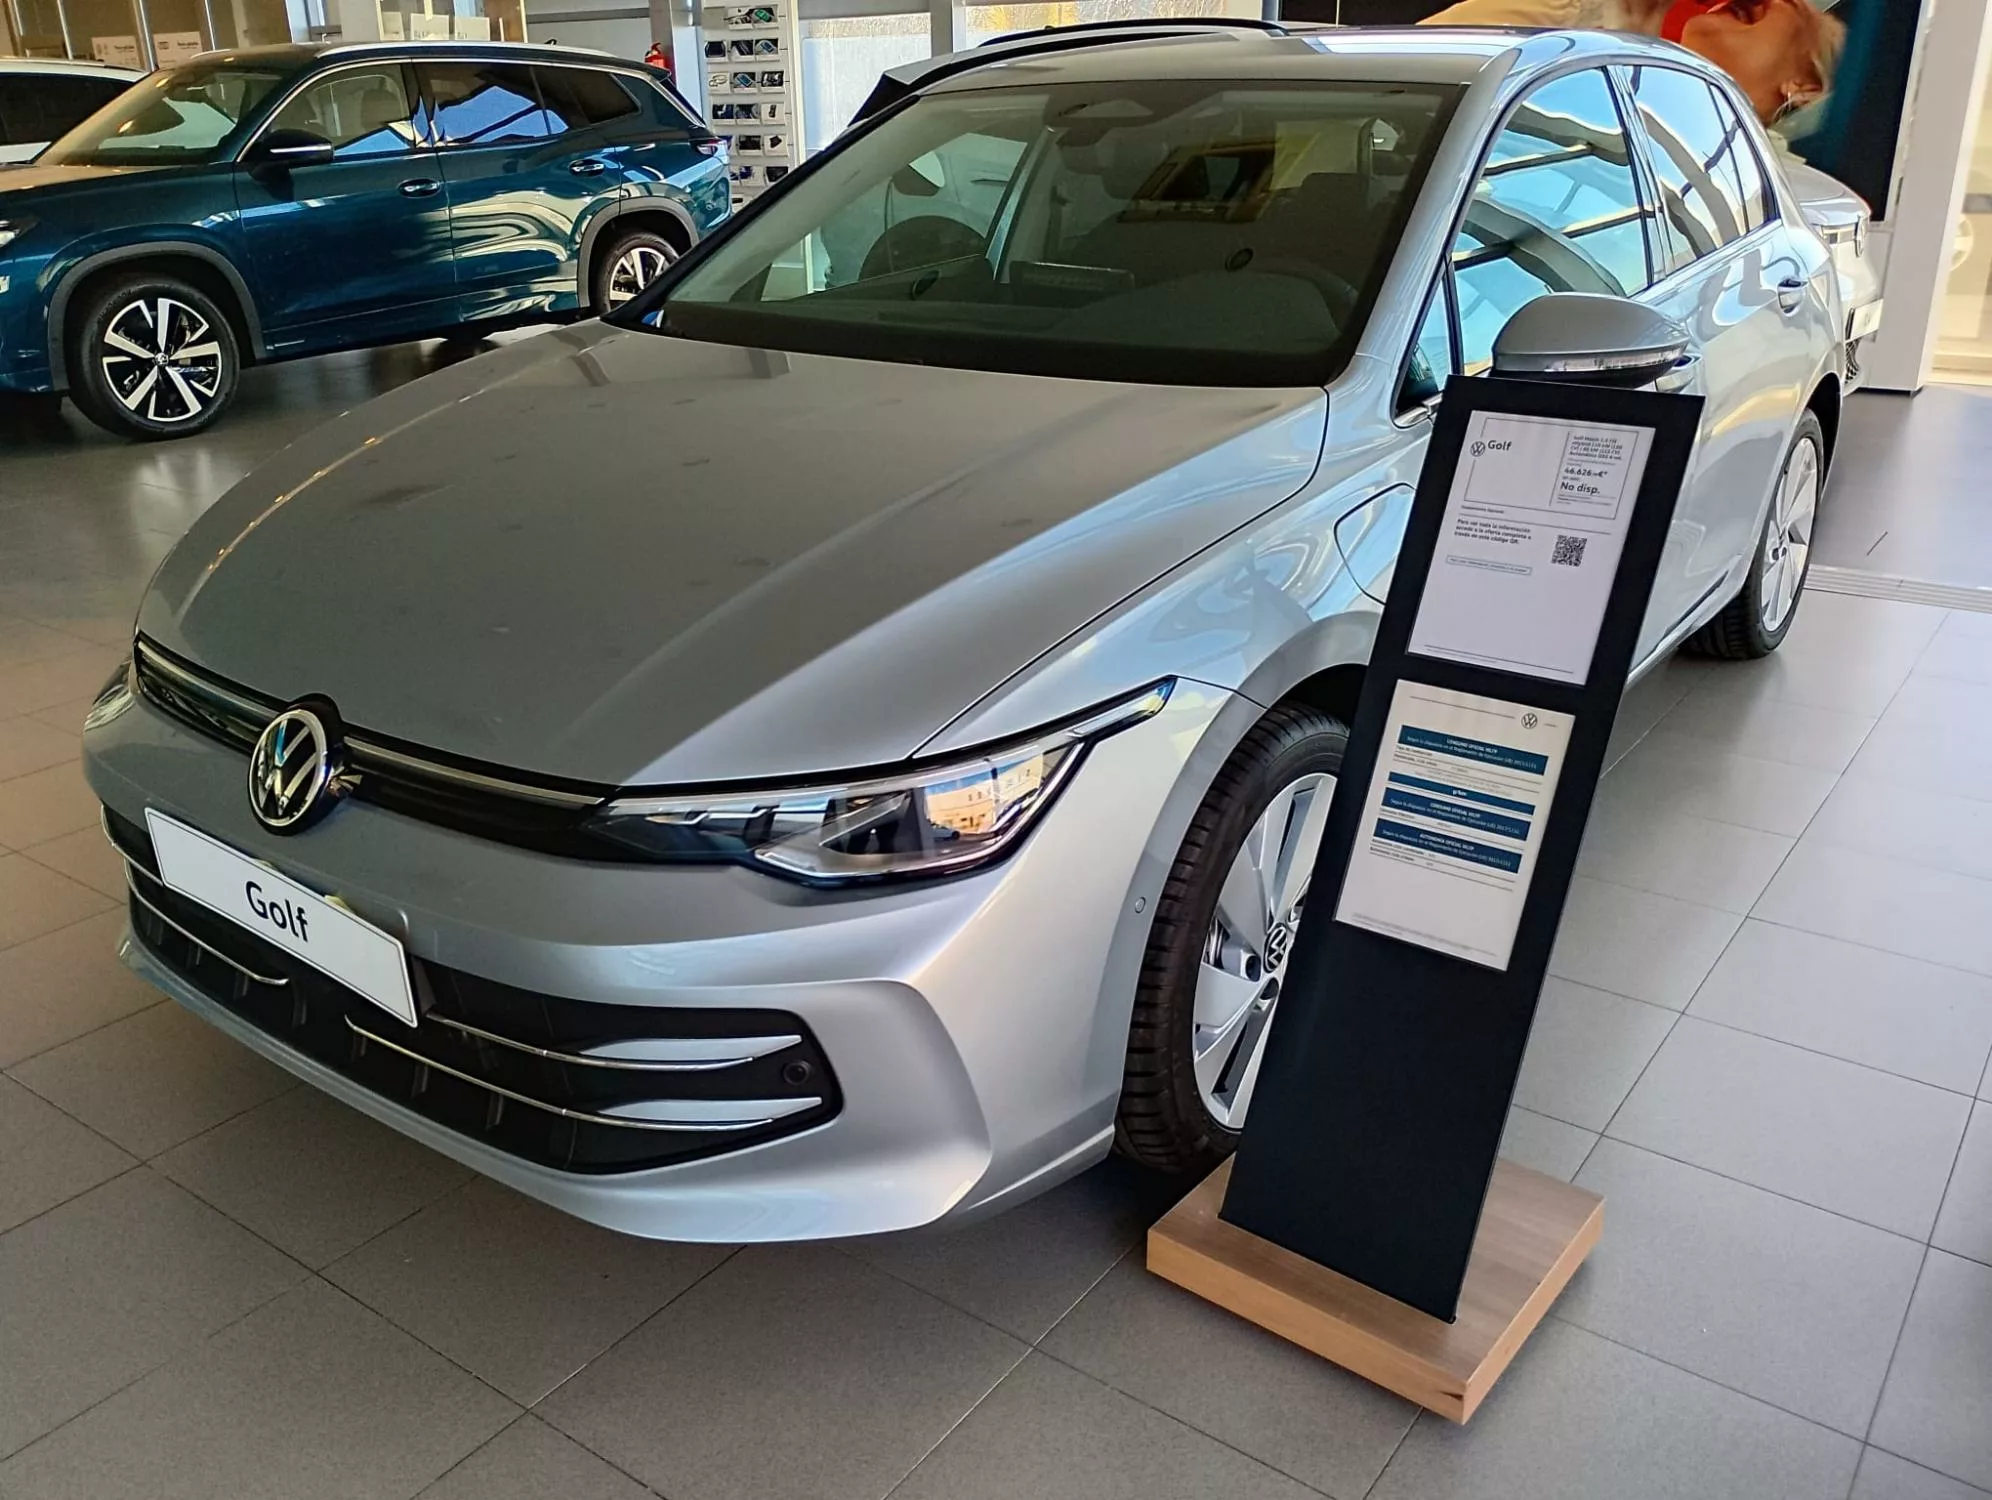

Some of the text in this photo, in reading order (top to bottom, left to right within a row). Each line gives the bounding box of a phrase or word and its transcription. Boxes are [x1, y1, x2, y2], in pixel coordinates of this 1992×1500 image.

[1488, 439, 1512, 451] Golf
[1560, 482, 1575, 491] No
[1576, 484, 1602, 497] disp.
[246, 881, 308, 943] Golf
